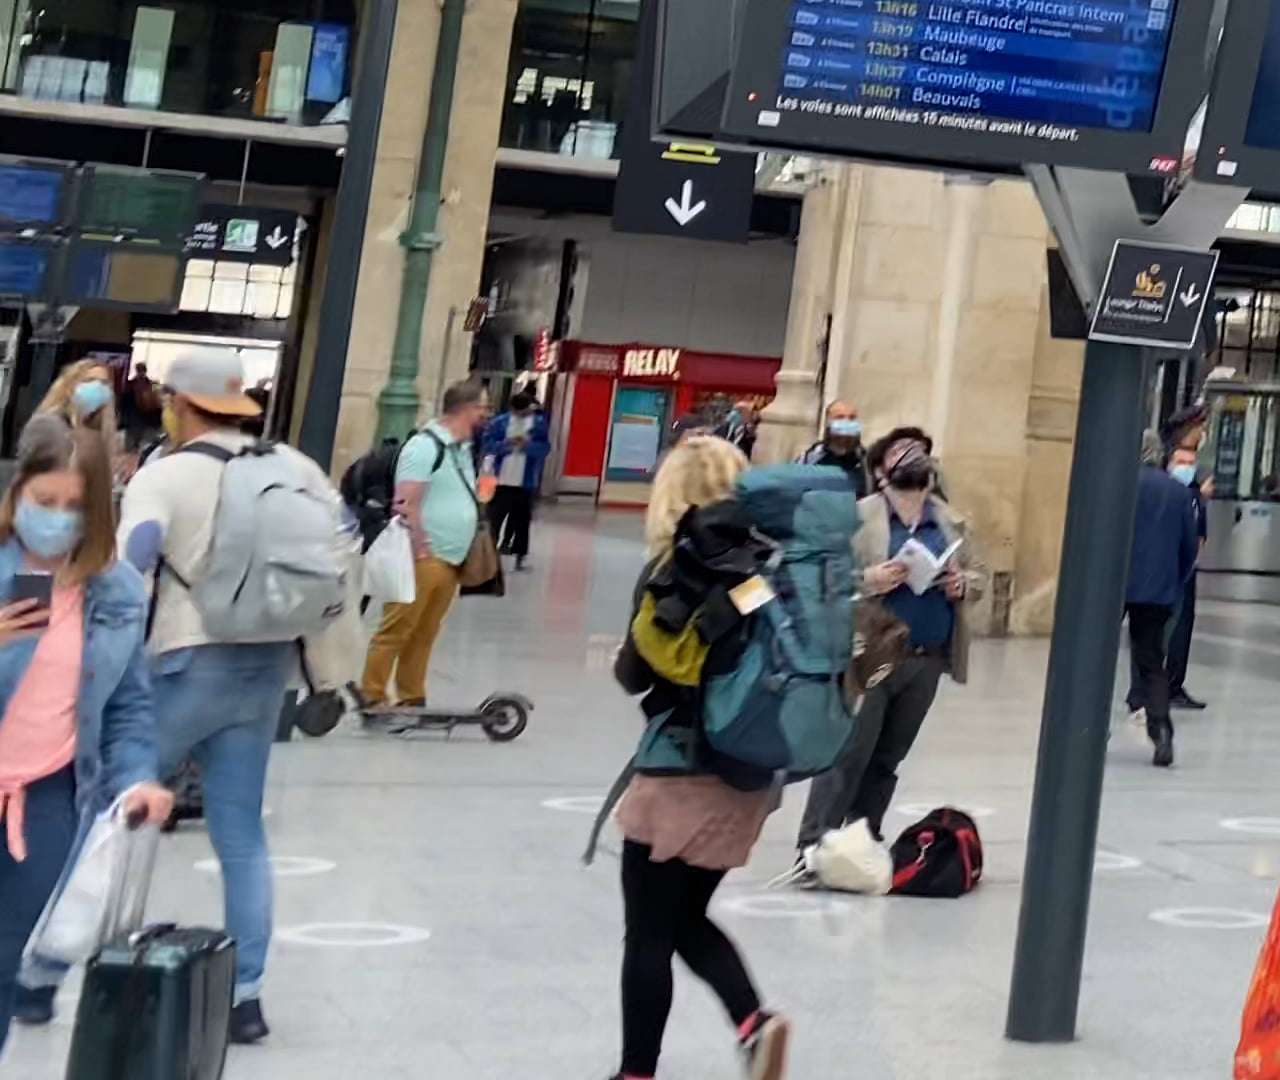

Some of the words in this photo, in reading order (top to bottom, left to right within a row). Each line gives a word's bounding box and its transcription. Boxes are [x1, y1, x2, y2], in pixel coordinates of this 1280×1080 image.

[923, 24, 1006, 53] Maubeuge
[920, 46, 969, 67] Calais
[776, 95, 798, 111] Les
[799, 99, 833, 115] voies
[912, 87, 981, 110] Beauvais
[622, 348, 681, 378] RELAY
